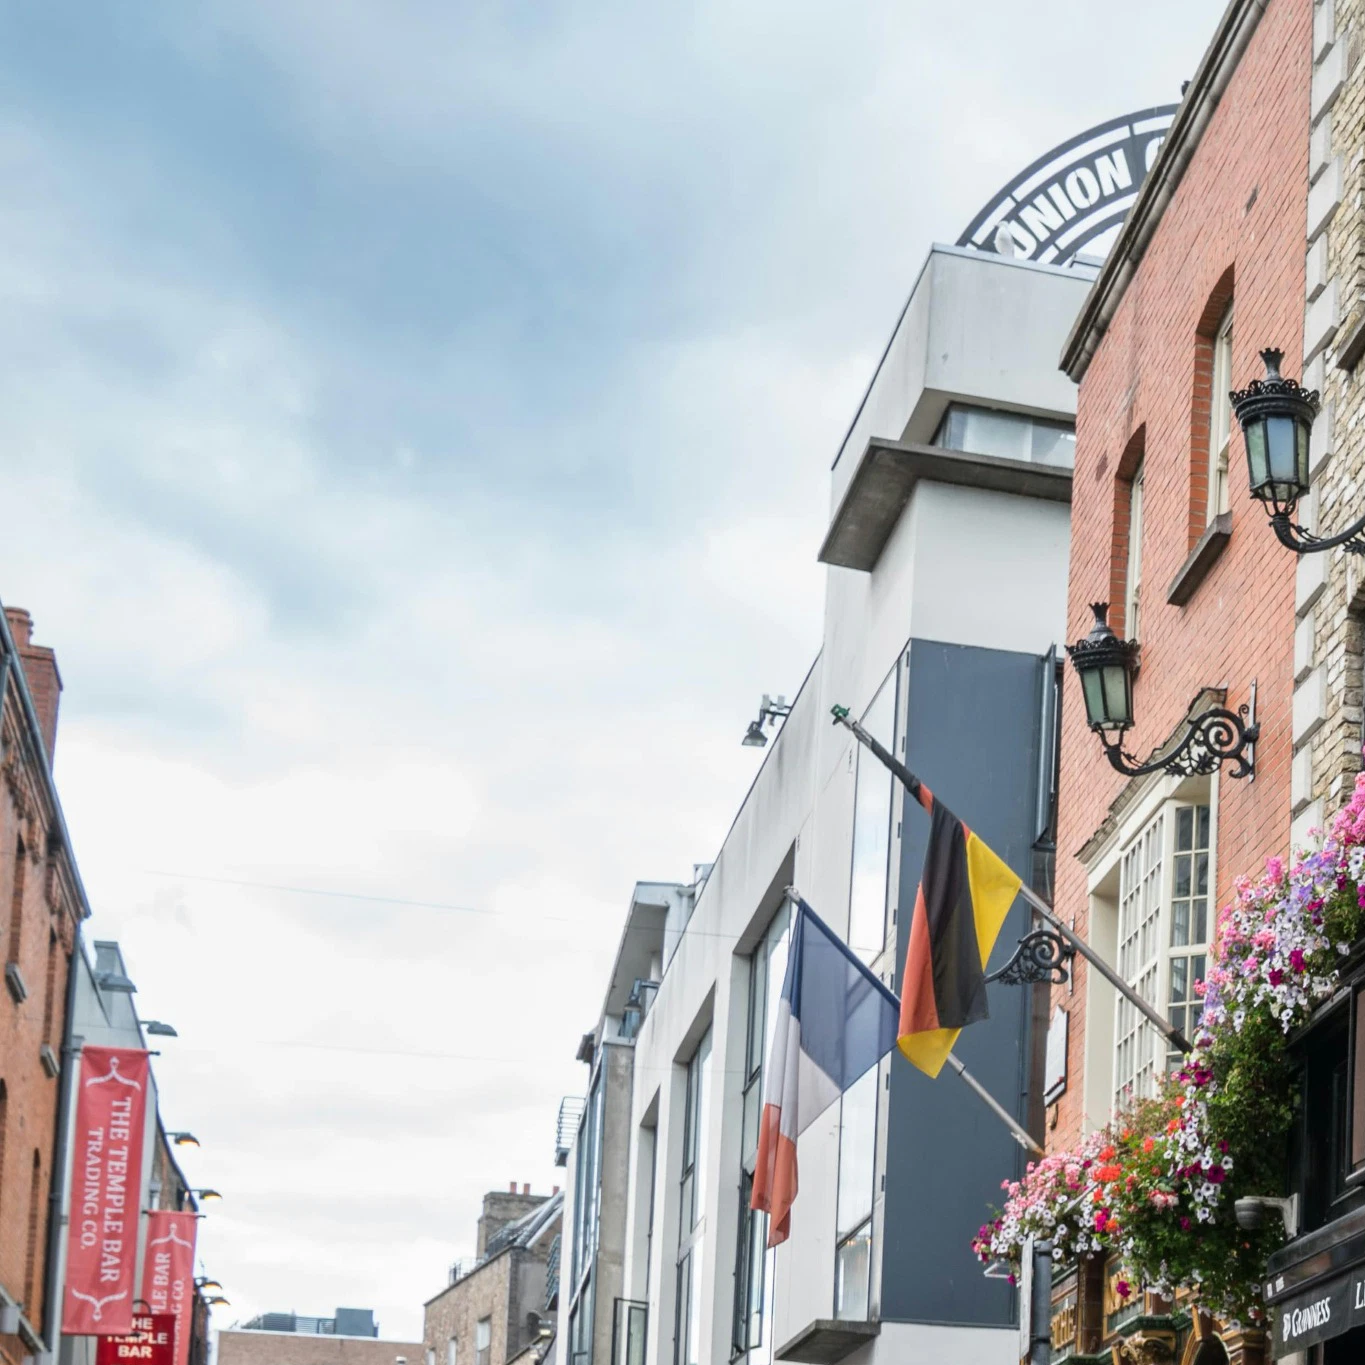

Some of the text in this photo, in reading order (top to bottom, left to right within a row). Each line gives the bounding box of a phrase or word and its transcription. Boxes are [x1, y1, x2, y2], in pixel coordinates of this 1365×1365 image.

[1008, 148, 1133, 261] UNION
[81, 1126, 104, 1249] TRADING CO.
[100, 1097, 132, 1283] THE TEMPLE BAR
[153, 1252, 171, 1286] BAR
[131, 1317, 153, 1330] HE
[1292, 1296, 1332, 1337] GUINNESS
[118, 1345, 153, 1358] BAR
